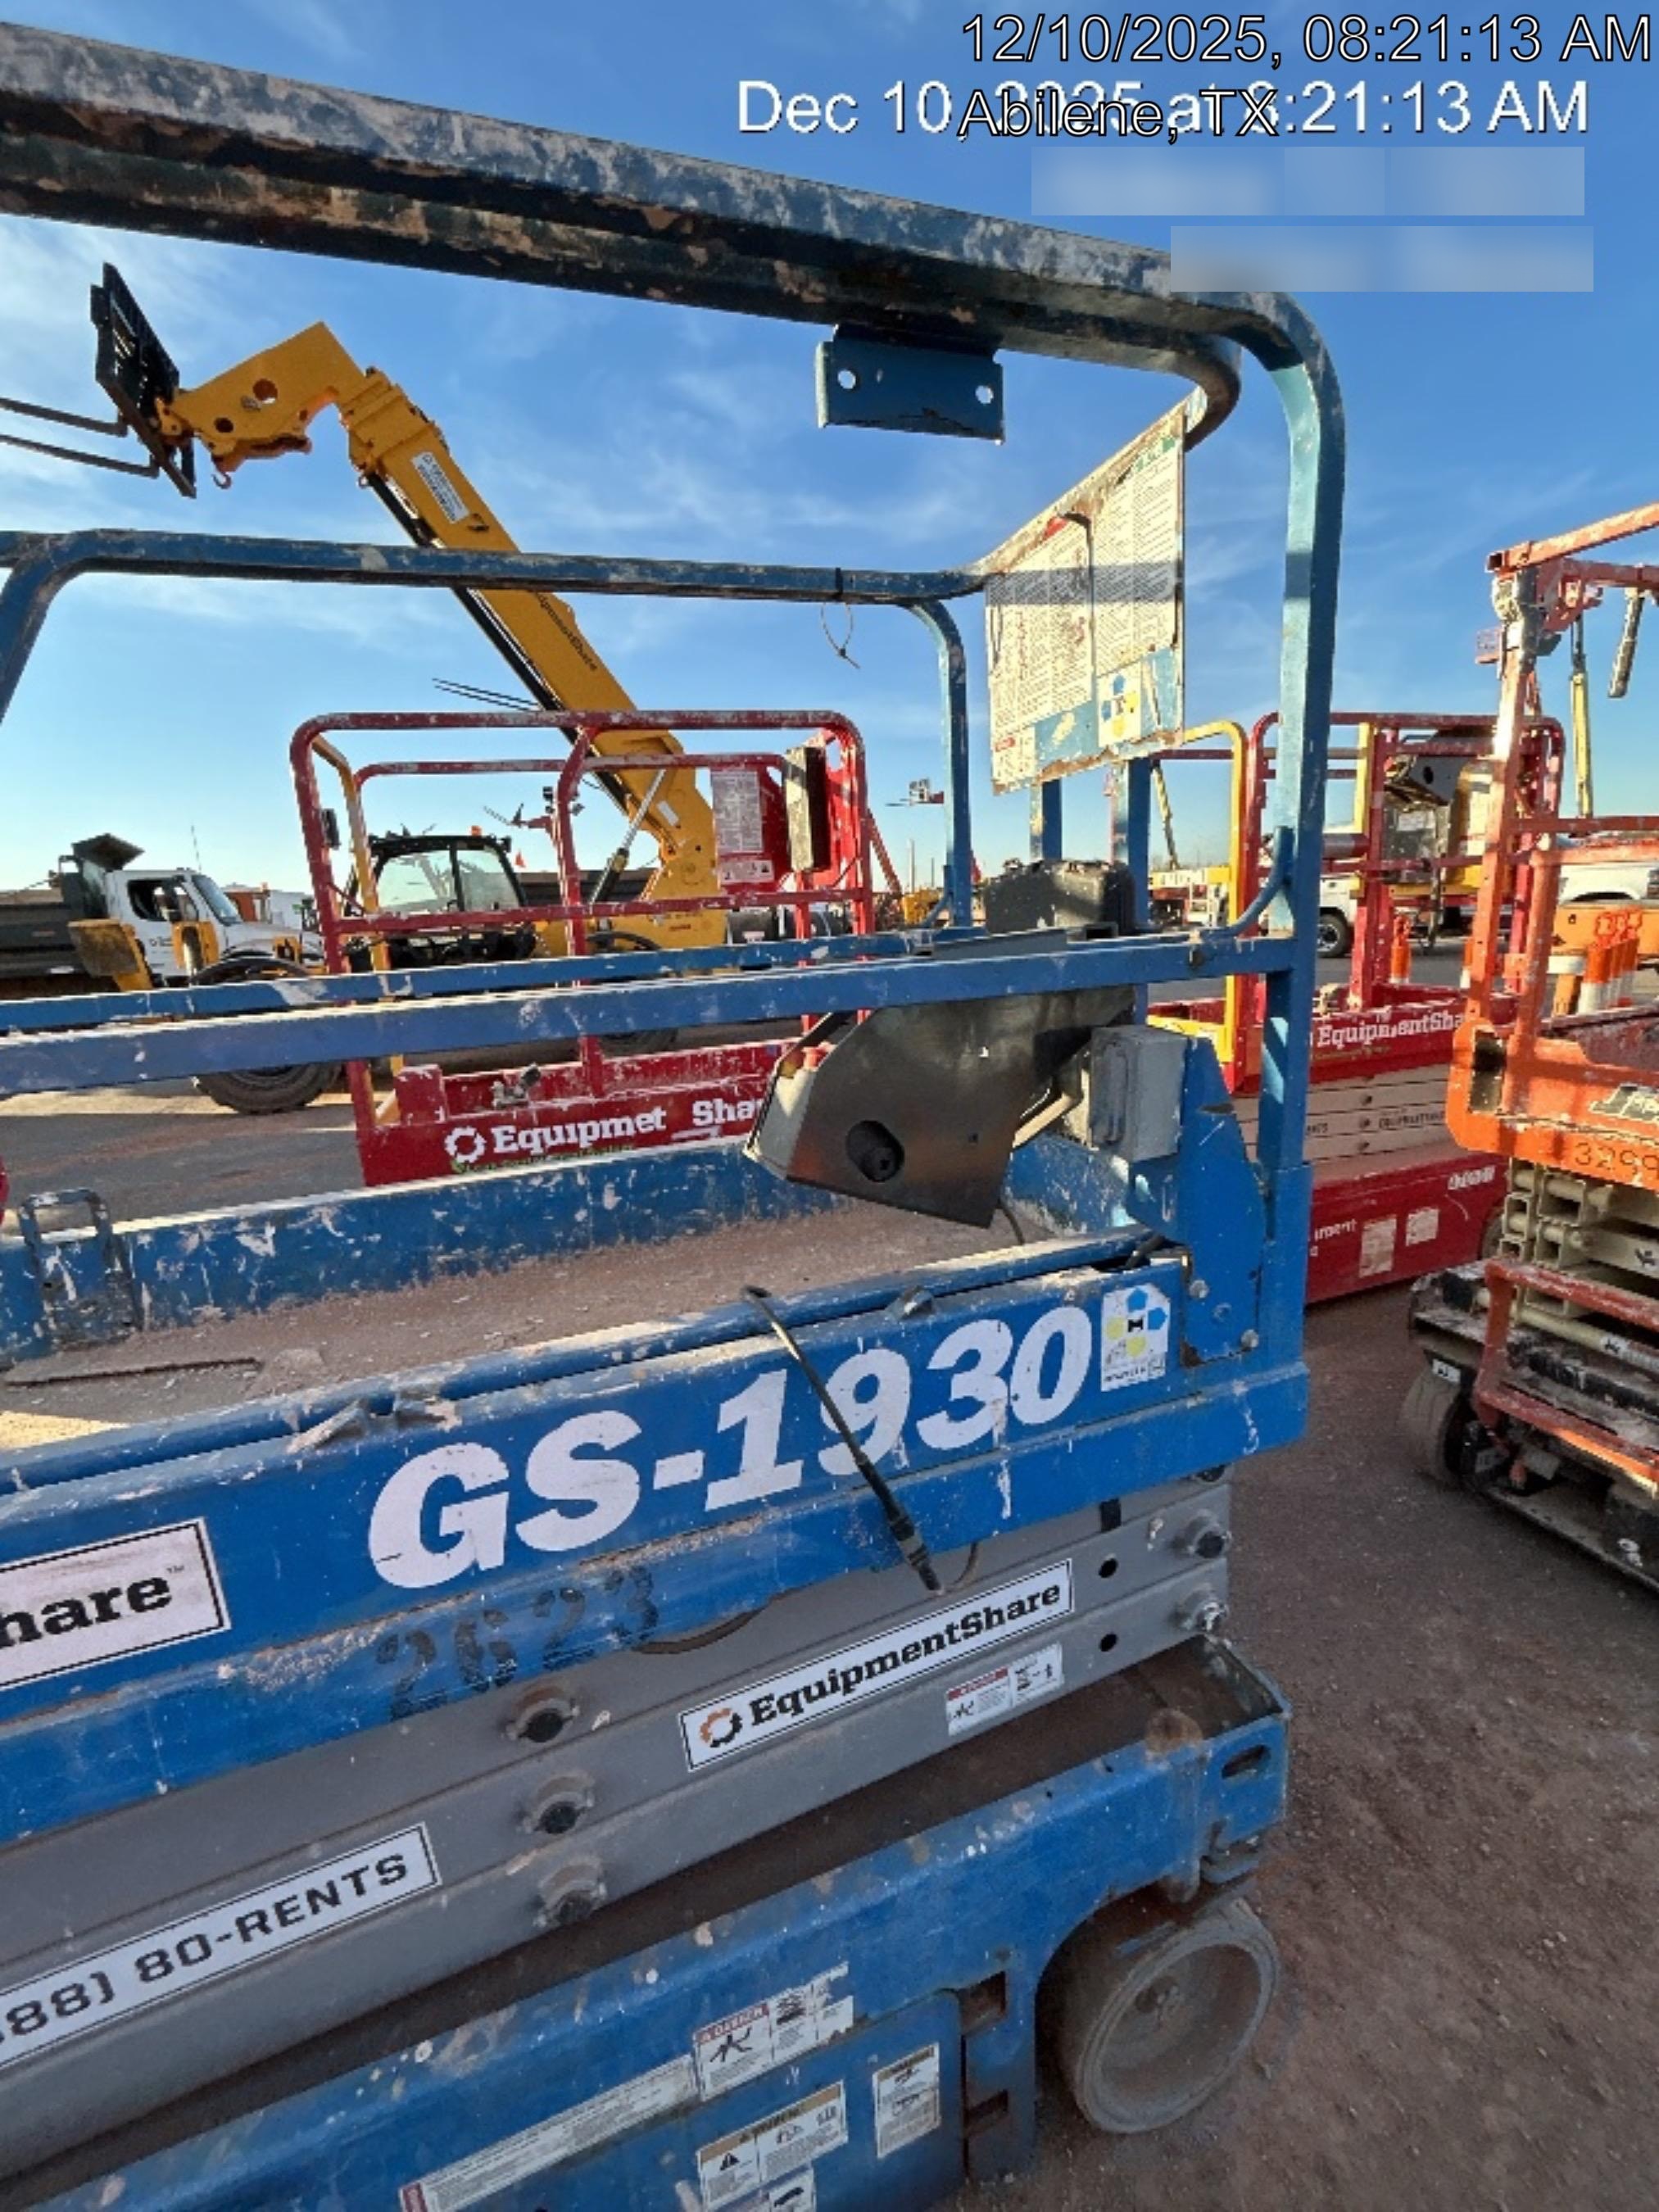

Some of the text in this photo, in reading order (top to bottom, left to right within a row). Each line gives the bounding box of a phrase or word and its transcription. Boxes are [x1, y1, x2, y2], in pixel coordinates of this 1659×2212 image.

[367, 1306, 1094, 1589] GS-1930
[749, 1584, 1060, 1726] EquipmentShare
[0, 1853, 407, 2045] 88) 80-RENTS
